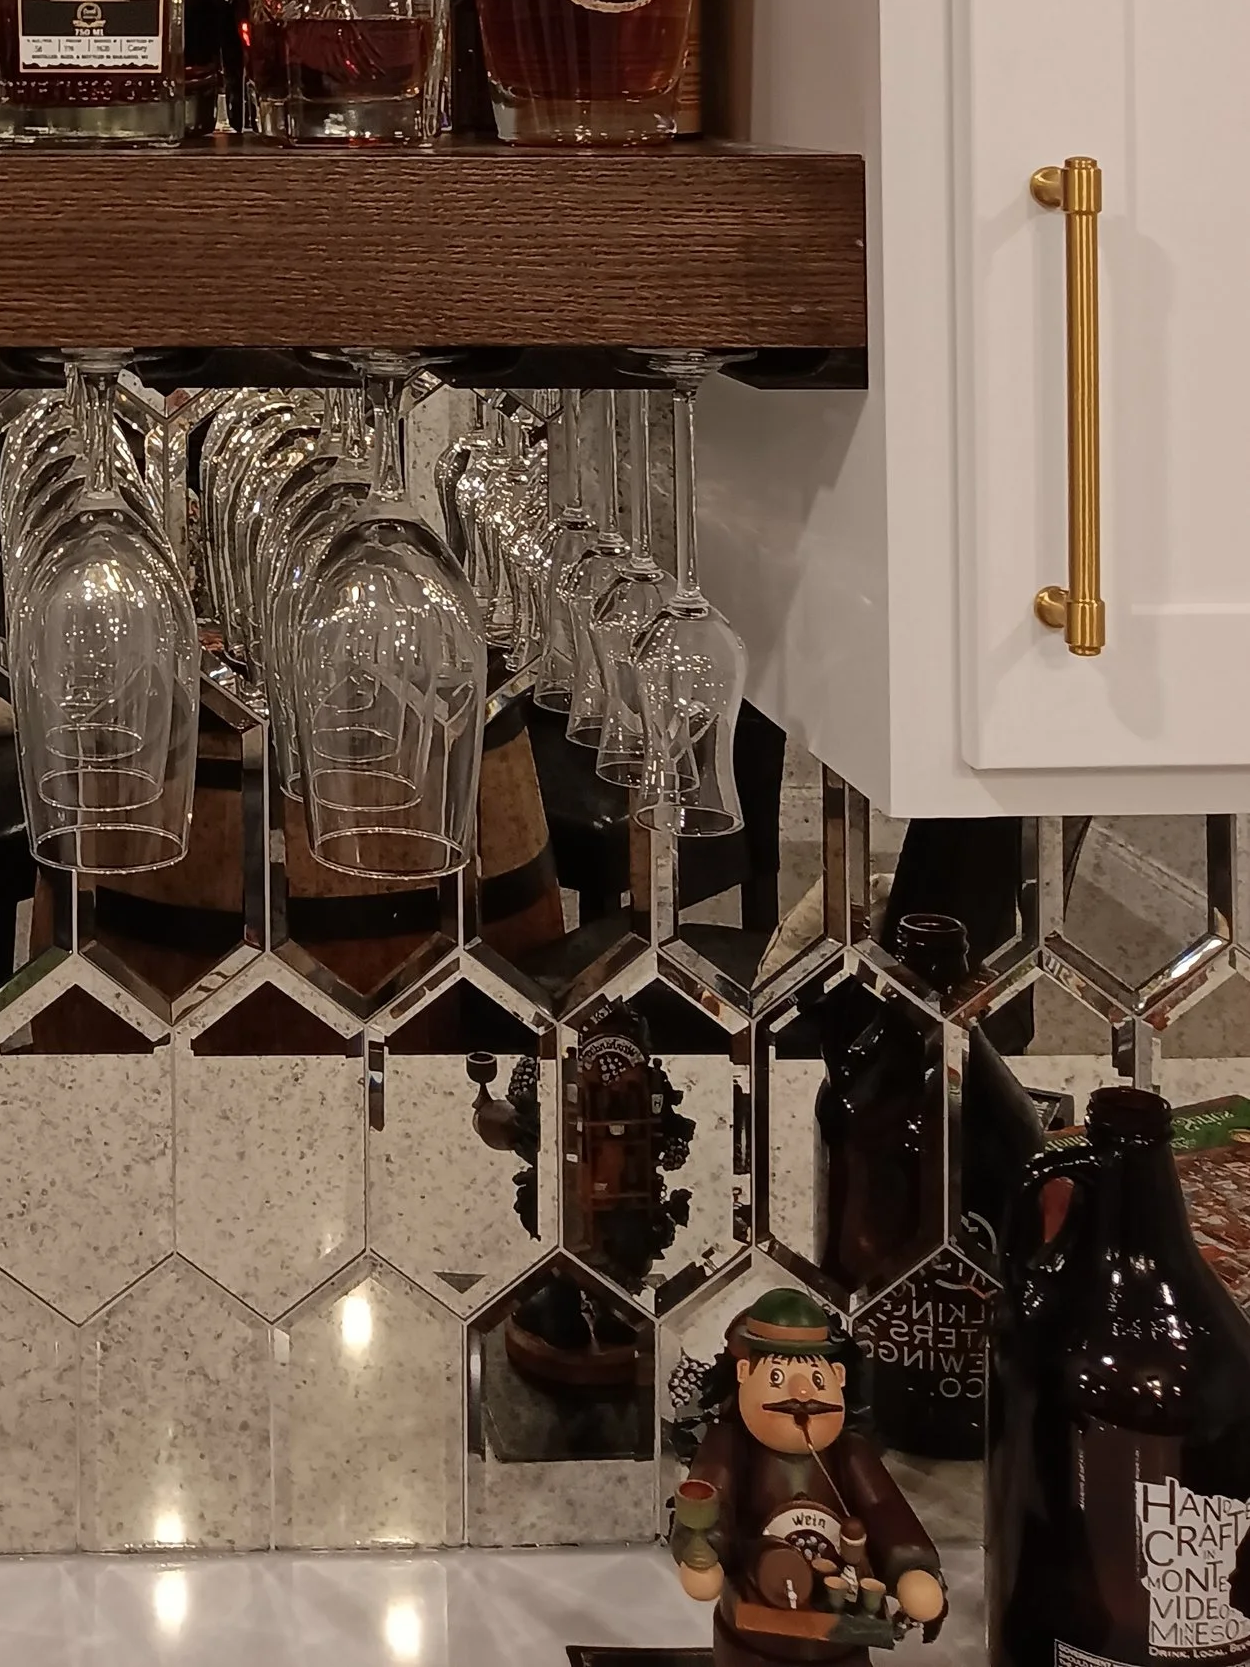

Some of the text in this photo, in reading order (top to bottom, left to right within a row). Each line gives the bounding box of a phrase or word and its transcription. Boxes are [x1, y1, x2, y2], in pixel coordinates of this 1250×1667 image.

[75, 28, 90, 36] 750
[1142, 1480, 1232, 1525] HAND
[791, 1512, 827, 1530] Wein
[1203, 1549, 1216, 1560] IN
[1149, 1560, 1231, 1592] MONTE
